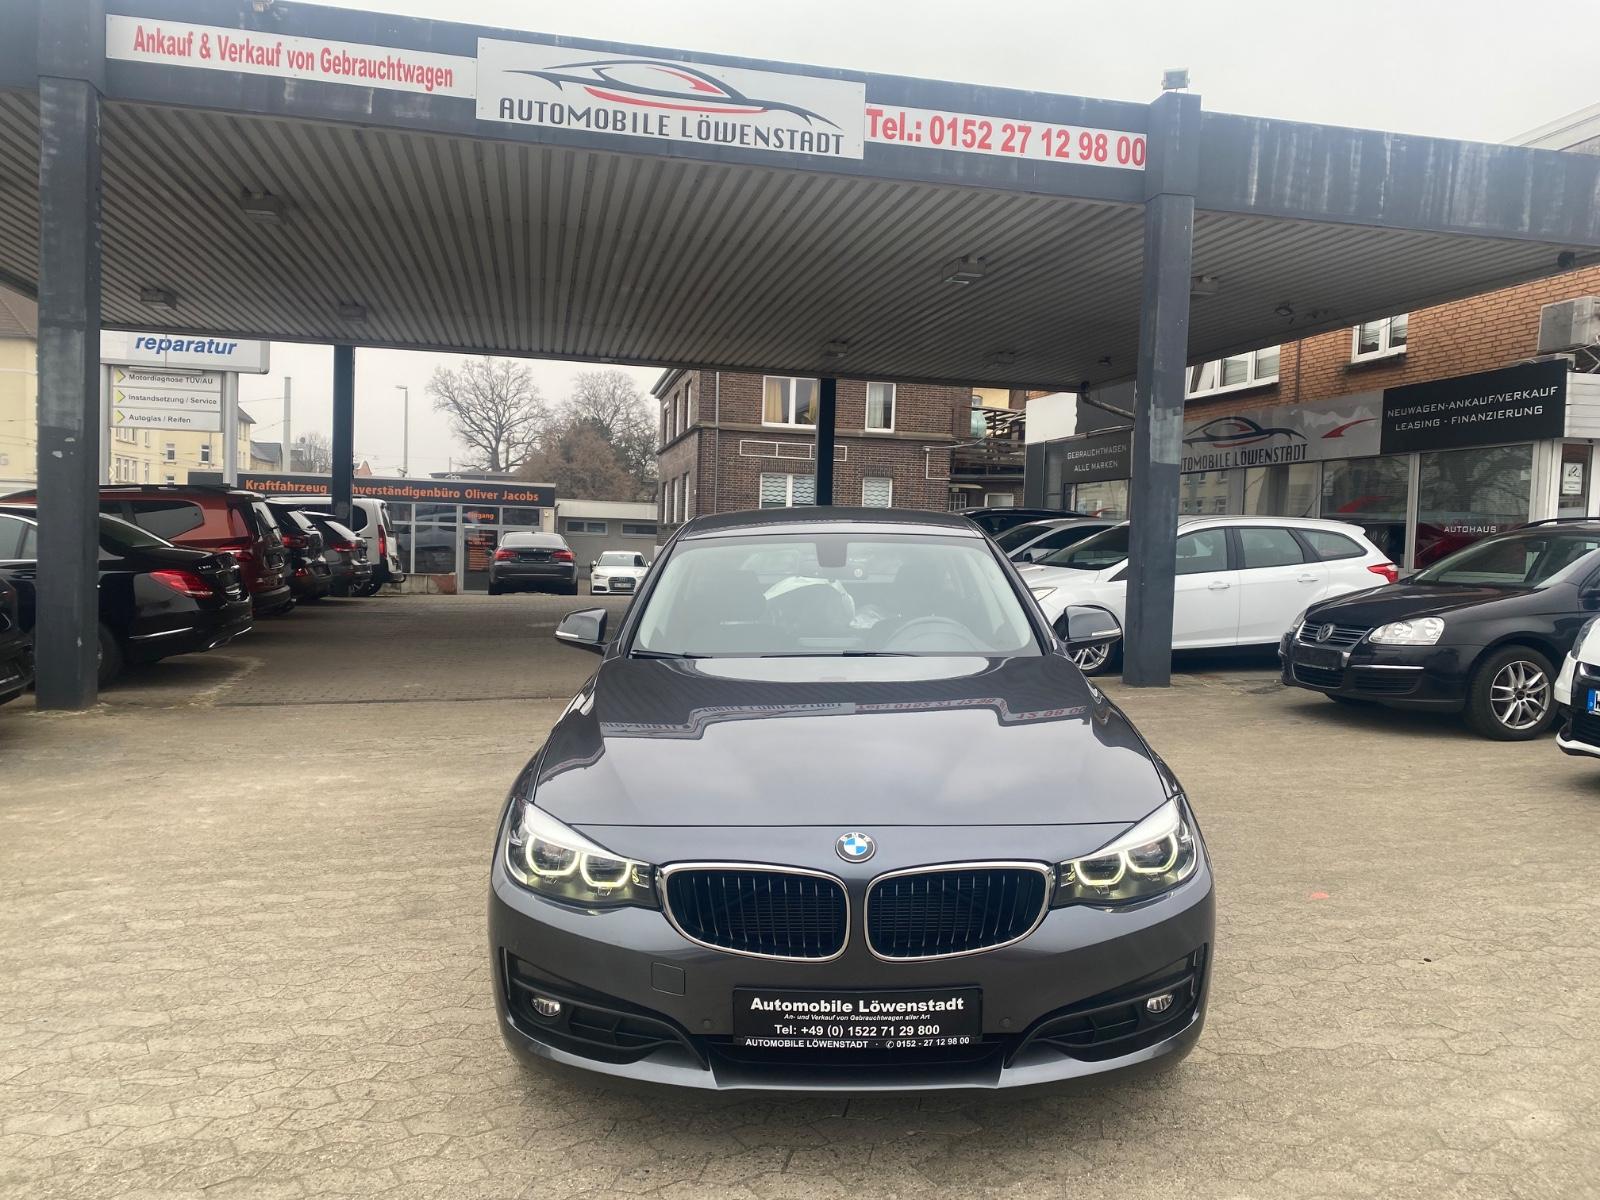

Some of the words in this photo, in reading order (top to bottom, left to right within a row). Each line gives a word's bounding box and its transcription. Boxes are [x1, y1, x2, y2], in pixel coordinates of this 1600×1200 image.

[133, 25, 194, 57] Ankauf
[199, 32, 211, 60] &
[217, 34, 282, 68] Verkauf
[287, 49, 315, 72] von
[320, 47, 454, 92] Gebrauchtwagen
[499, 97, 671, 137] AUTOMOBILE
[681, 114, 845, 155] LÖWENSTADT
[866, 108, 922, 143] Tel.:
[929, 115, 993, 151] 0152
[1001, 123, 1032, 154] 27
[1041, 128, 1070, 158] 12
[1078, 132, 1108, 162] 98
[1116, 135, 1146, 167] 00
[135, 335, 238, 355] reparatur
[128, 373, 184, 384] Motordiagnose
[128, 394, 185, 404] Instandsetzung
[190, 397, 217, 405] Service
[1387, 386, 1559, 418] NEUWAGEN-ANKAUF/VERKAUF
[128, 414, 161, 423] Autoglas
[167, 415, 191, 423] Reifen
[1395, 418, 1441, 431] LEASING
[1451, 405, 1544, 425] FINANZIERUNG
[1067, 444, 1127, 460] GEBRAUCHTWAGEN
[1180, 452, 1231, 471] TOMOBILE
[1234, 443, 1308, 467] LÖWENSTADT
[1074, 463, 1090, 472] ALLE
[1091, 460, 1118, 470] MARKEN
[245, 479, 328, 496] Kraftfahrzeug
[352, 484, 461, 499] hverständigenbüro
[464, 488, 498, 500] Oliver
[502, 490, 539, 501] Jacobs
[1444, 525, 1497, 533] AUTOHAUS
[750, 997, 853, 1013] Automobile
[858, 997, 964, 1013] Löwenstadt
[850, 1014, 904, 1022] Gebrauchtwagen
[774, 1024, 797, 1035] Tel:
[801, 1025, 824, 1036] +49
[827, 1024, 844, 1038] (0)
[848, 1026, 877, 1037] 1522
[881, 1026, 895, 1037] 71
[899, 1025, 914, 1036] 29
[918, 1024, 940, 1035] 800
[745, 1038, 805, 1048] AUTOMOBILE
[806, 1039, 869, 1048] LÖWENSTADT
[896, 1040, 916, 1048] 0152
[923, 1039, 934, 1047] 27
[936, 1038, 946, 1046] 12
